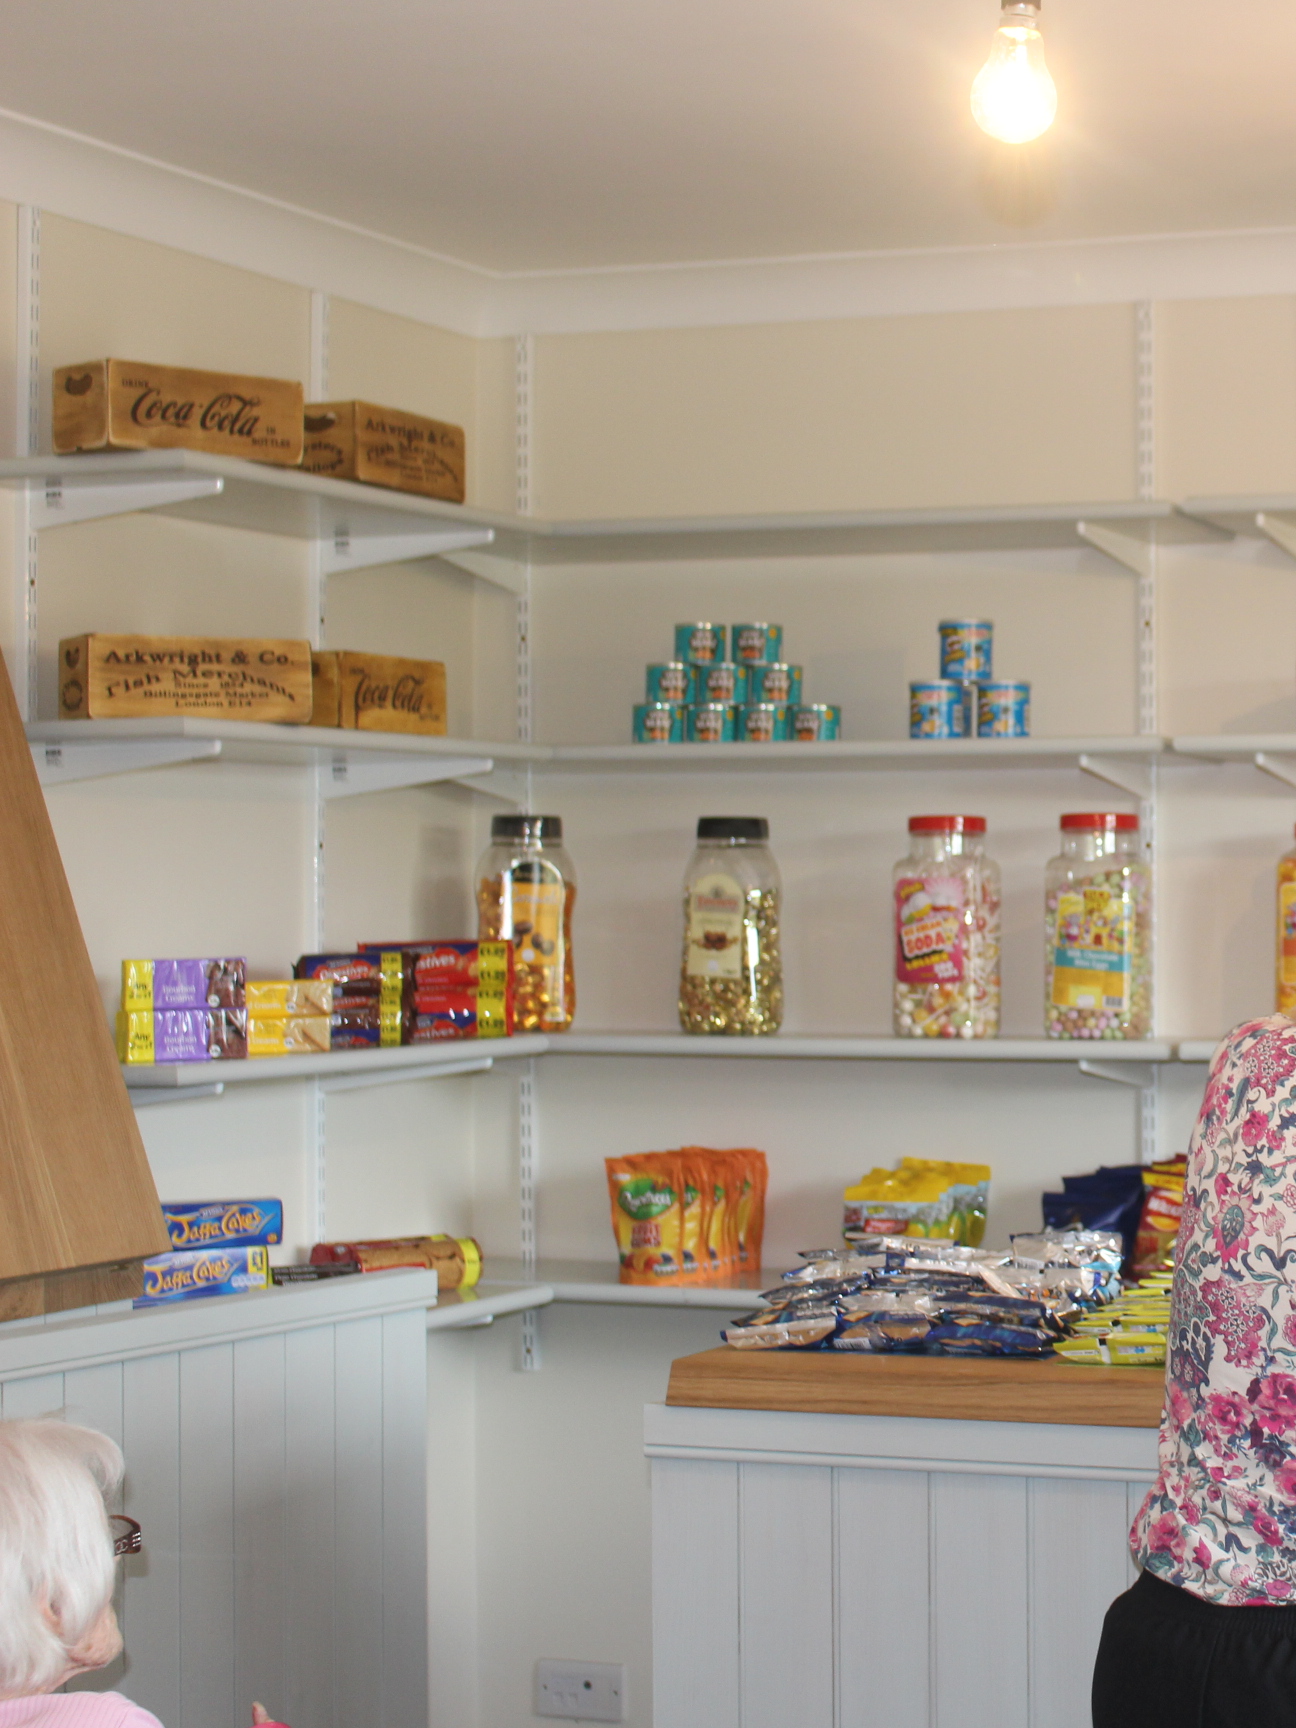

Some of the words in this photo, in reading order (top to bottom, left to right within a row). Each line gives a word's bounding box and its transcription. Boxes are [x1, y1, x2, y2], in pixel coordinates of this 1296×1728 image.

[104, 649, 222, 669] Arkwright
[230, 651, 249, 665] &
[905, 930, 946, 955] SODA
[165, 1212, 220, 1244] Jaffa
[221, 1205, 263, 1236] Cakes
[143, 1265, 192, 1294] Jaffa
[192, 1255, 231, 1284] Cakes
